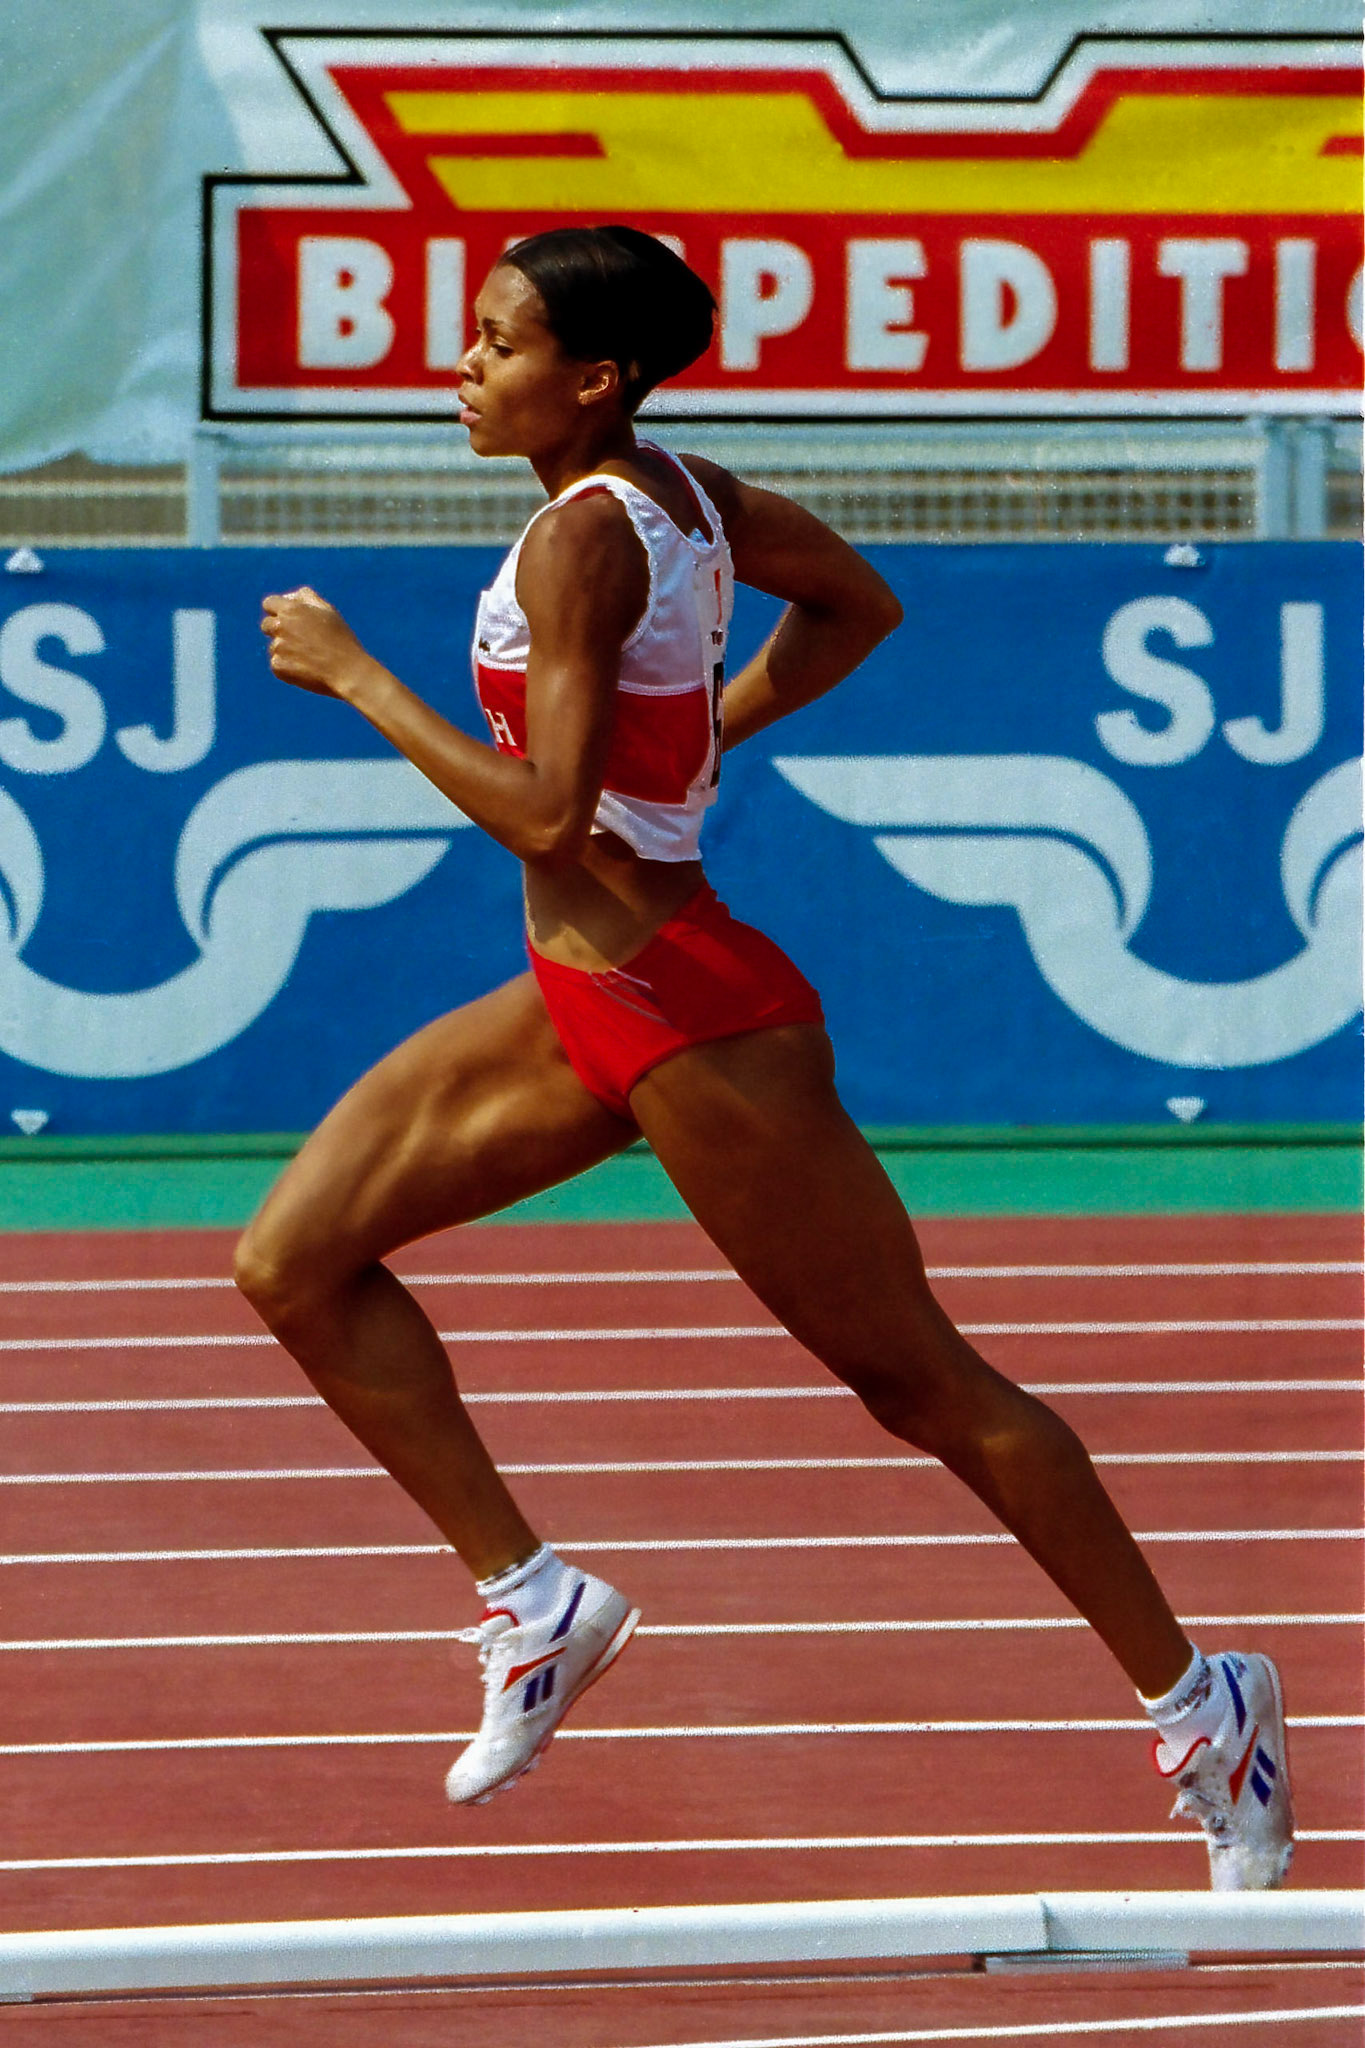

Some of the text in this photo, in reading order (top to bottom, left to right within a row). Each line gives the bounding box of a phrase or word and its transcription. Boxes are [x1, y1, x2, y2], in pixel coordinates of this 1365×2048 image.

[297, 234, 1363, 373] BIPEDITI
[0, 603, 216, 774] SJ
[1095, 595, 1325, 766] SJ
